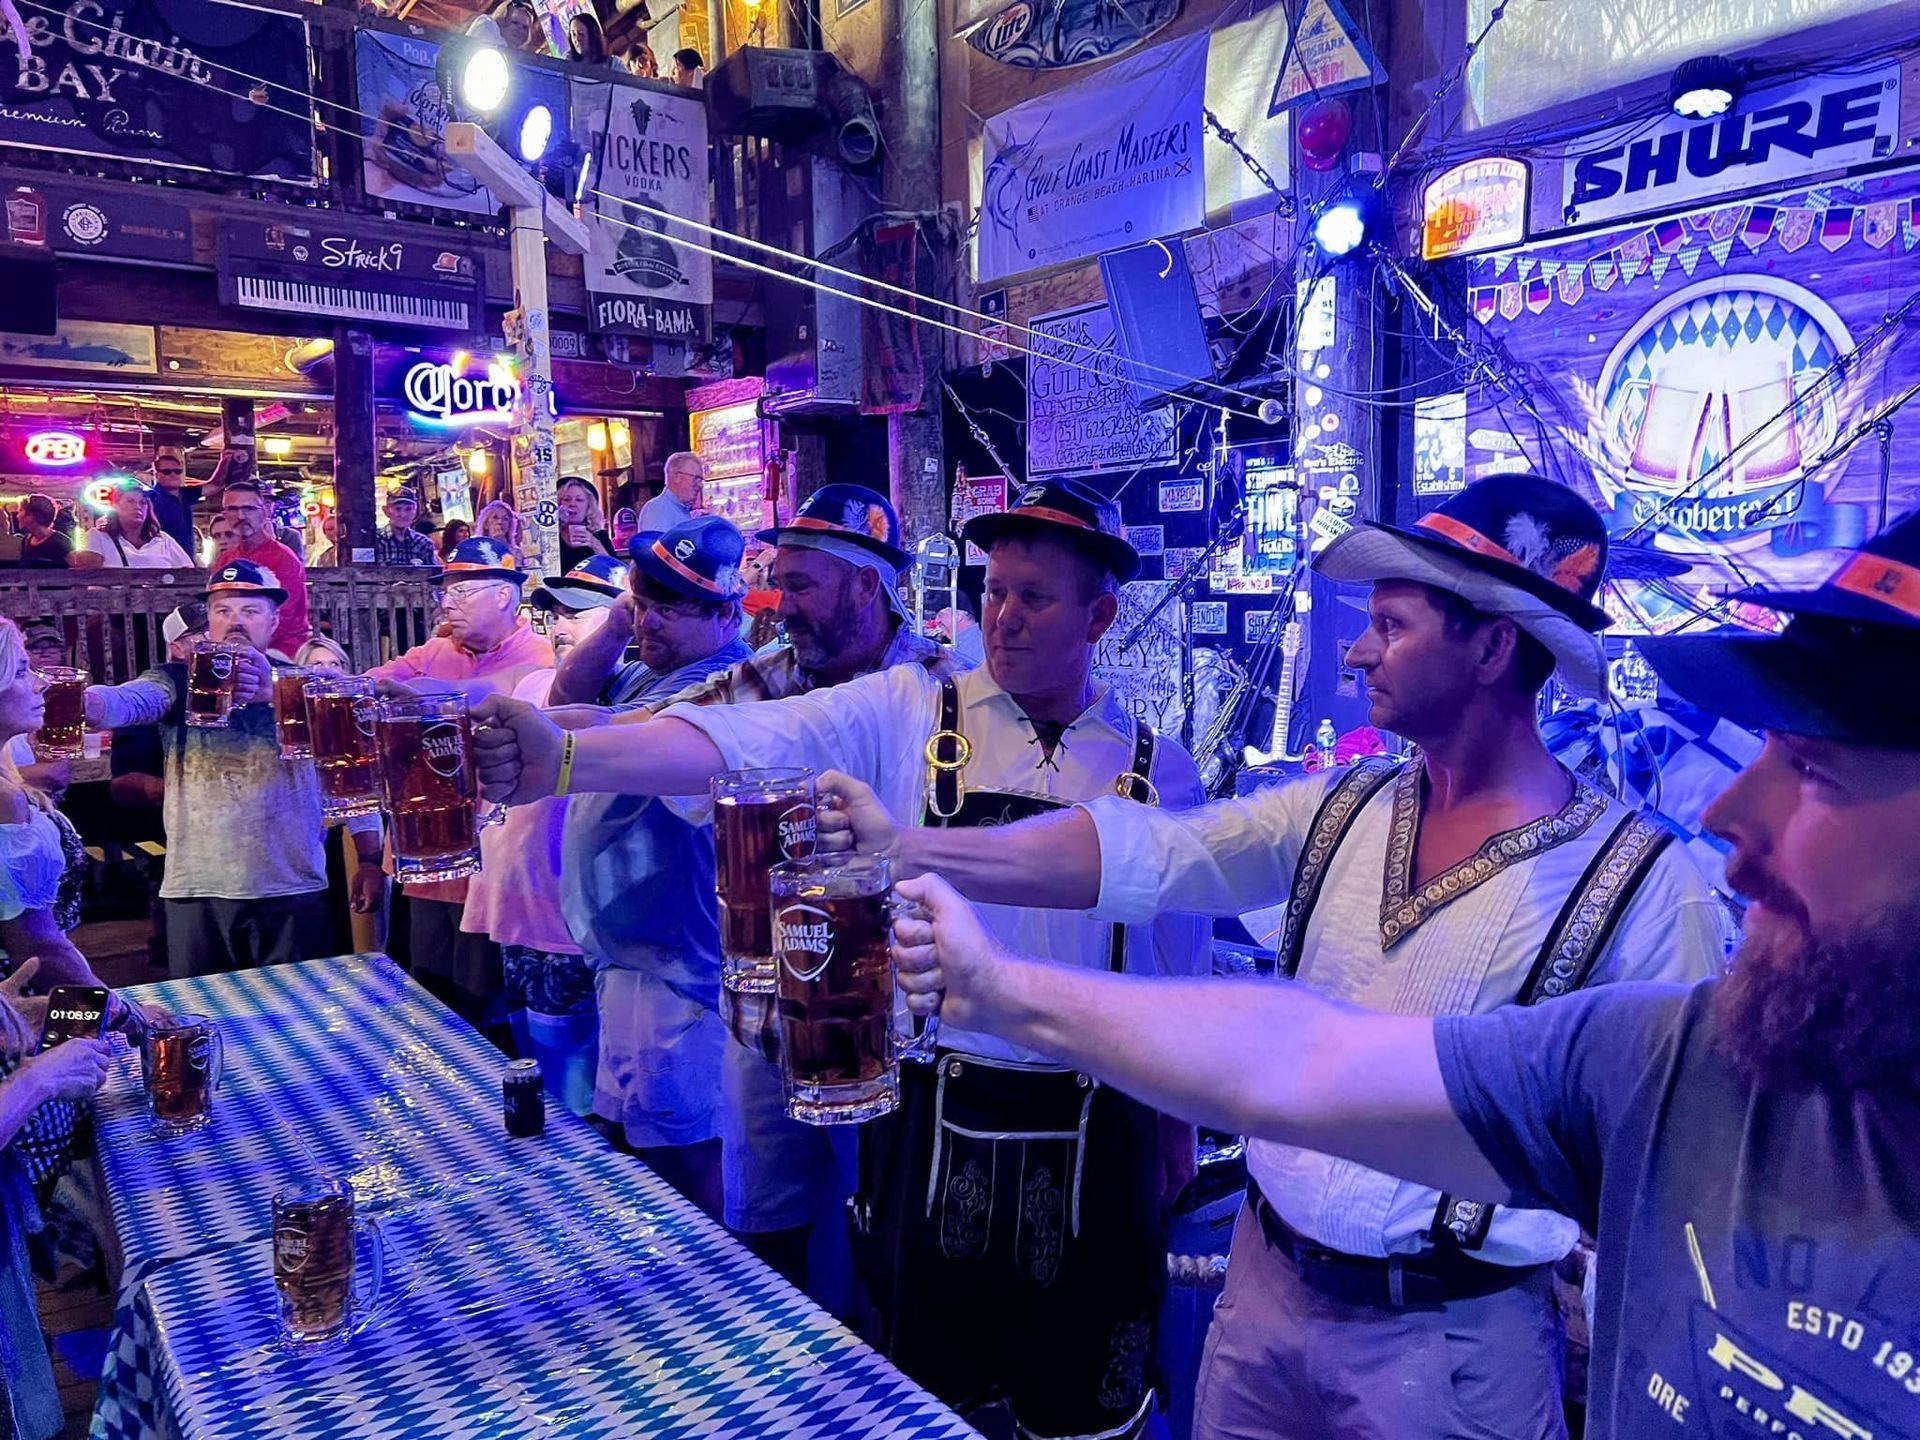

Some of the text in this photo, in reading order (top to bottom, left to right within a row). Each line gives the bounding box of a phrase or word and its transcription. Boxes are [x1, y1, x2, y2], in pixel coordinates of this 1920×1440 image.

[995, 12, 1029, 51] Lite
[14, 53, 126, 102] BAY
[0, 103, 163, 139] remium Rum
[591, 131, 690, 180] PICKERS
[1573, 81, 1885, 206] SHURE
[1025, 121, 1190, 202] GULF COAST MASTERS
[624, 174, 663, 193] VODKA
[1040, 166, 1172, 216] AT ORANGE BEACH MARINA
[30, 436, 85, 458] OPEN
[421, 734, 465, 750] SAMUEL
[428, 745, 464, 760] ADAMS
[778, 817, 817, 837] SAMUEL
[783, 830, 816, 848] ADAMS
[778, 922, 835, 940] SAMUEL
[783, 938, 829, 955] ADAMS
[1648, 1373, 1690, 1423] ORE
